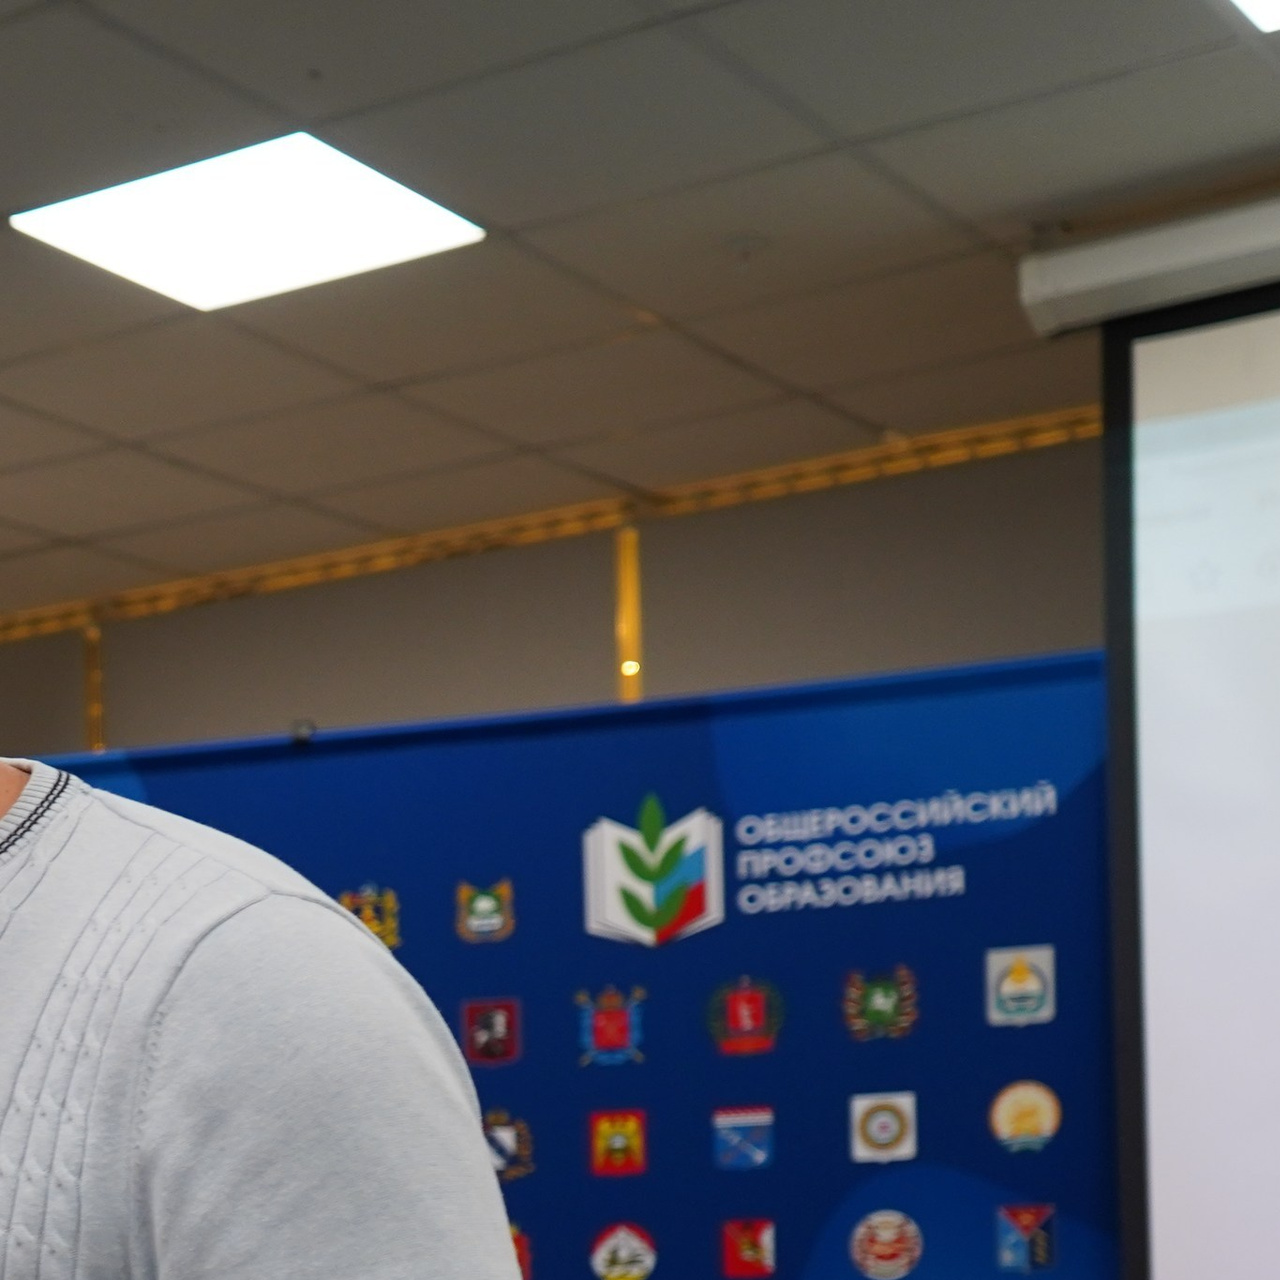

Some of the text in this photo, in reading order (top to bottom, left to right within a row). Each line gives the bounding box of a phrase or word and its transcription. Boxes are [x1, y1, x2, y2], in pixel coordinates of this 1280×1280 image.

[735, 779, 1058, 845] ОБЩЕРОССИЙСКИЙ
[736, 832, 936, 880] ПРОФСОЮЗ
[736, 864, 966, 915] ОБРАЗОВАНИЯ
